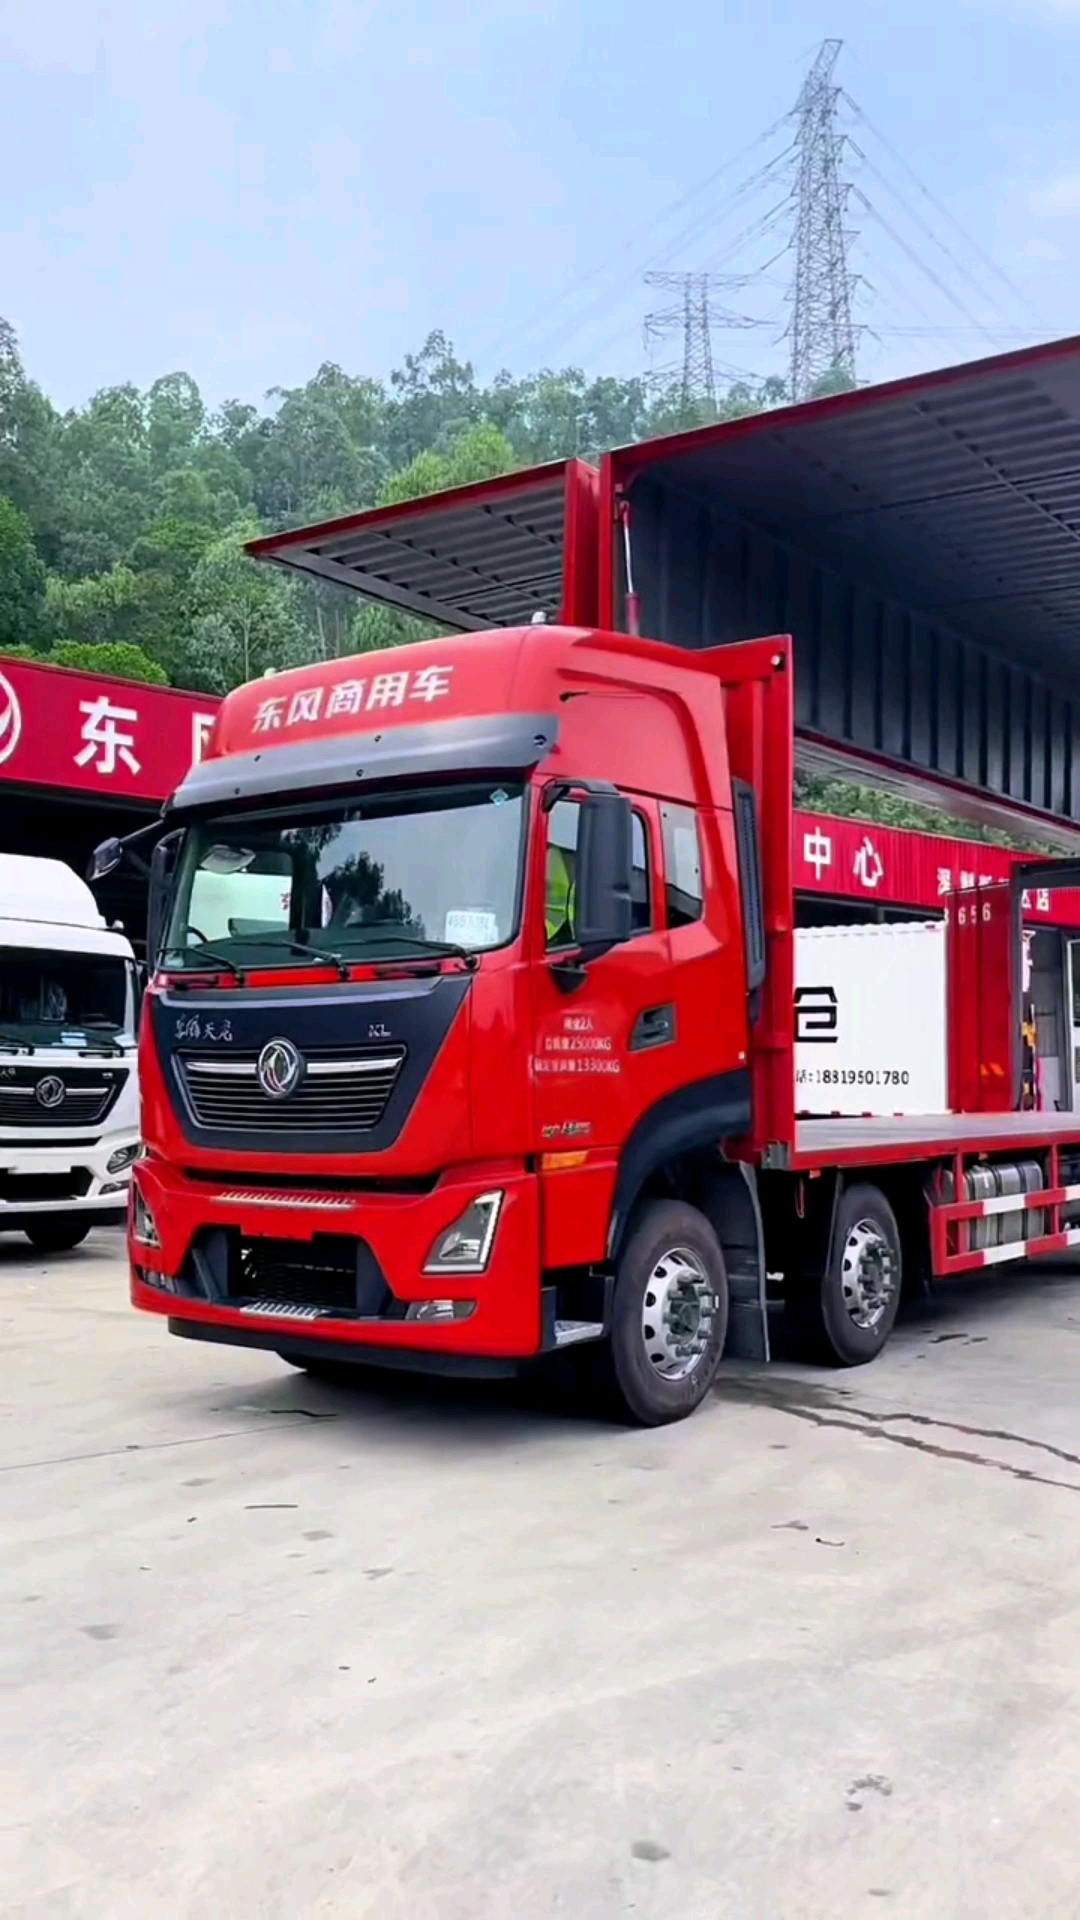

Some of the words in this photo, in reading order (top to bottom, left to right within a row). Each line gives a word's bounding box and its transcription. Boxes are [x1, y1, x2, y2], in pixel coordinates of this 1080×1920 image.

[252, 665, 454, 733] 东风商用车
[803, 825, 884, 888] 中心
